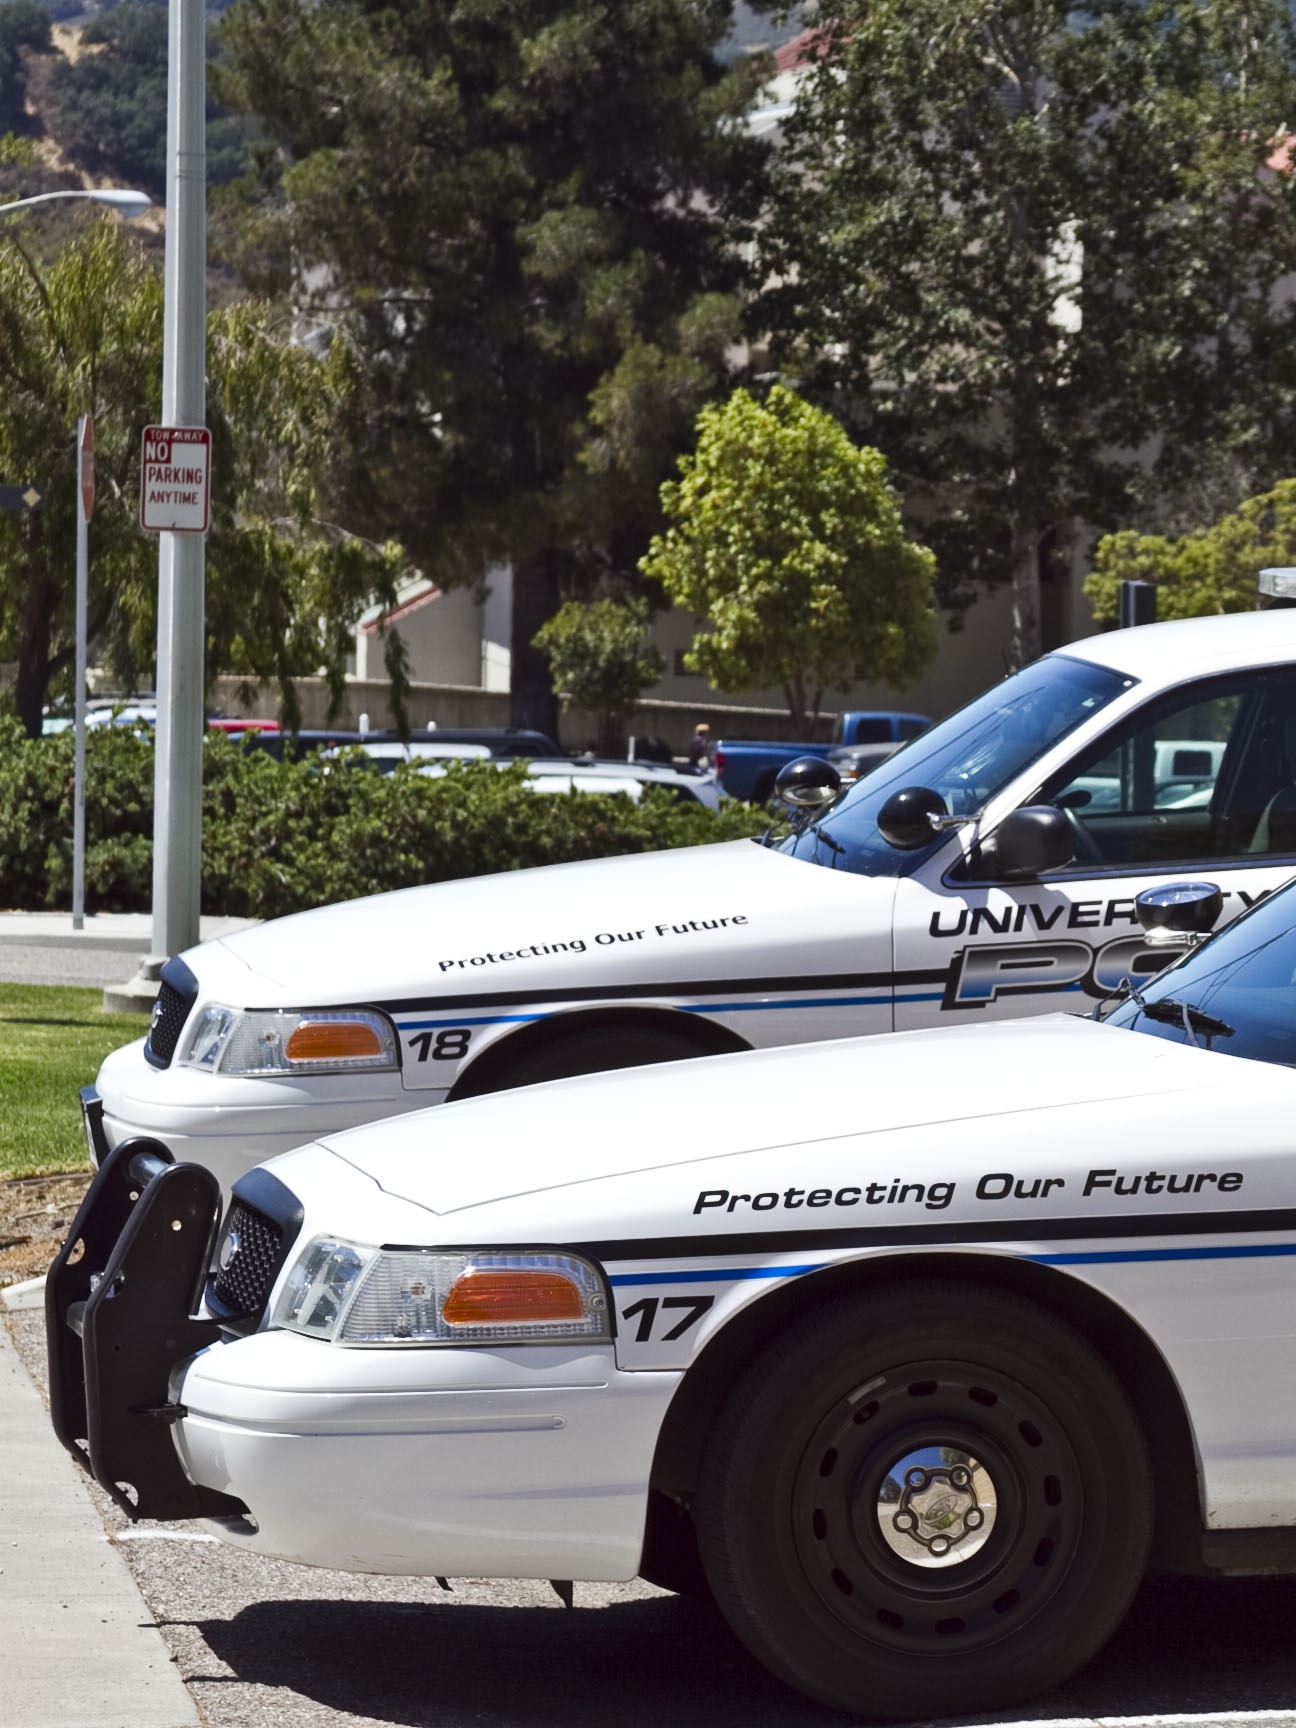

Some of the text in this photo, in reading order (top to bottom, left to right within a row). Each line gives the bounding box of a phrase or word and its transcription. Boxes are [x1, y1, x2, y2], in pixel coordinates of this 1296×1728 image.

[146, 441, 168, 460] NO
[148, 466, 202, 484] PARKING
[149, 490, 199, 505] ANYTIME
[438, 914, 749, 972] Protecting Our Future
[407, 1029, 472, 1062] 18
[693, 1168, 1244, 1215] Protecting Our Future
[622, 1296, 715, 1342] 17
